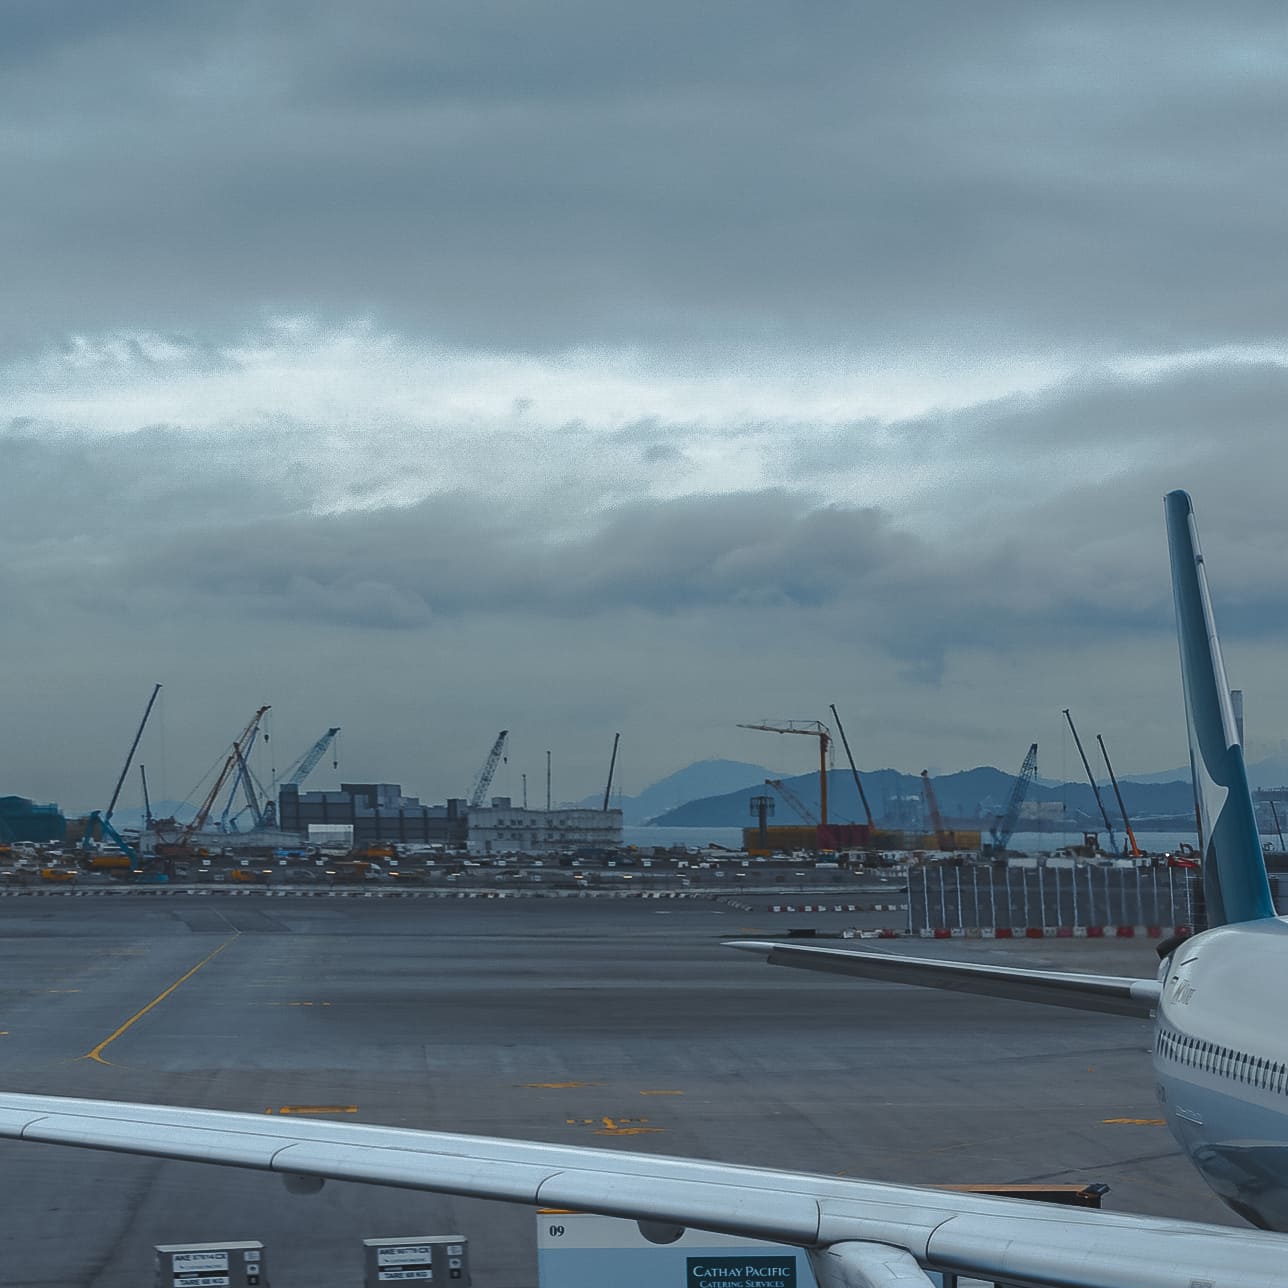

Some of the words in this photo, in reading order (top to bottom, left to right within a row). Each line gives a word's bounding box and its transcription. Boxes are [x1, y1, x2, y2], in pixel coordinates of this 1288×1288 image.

[549, 1224, 565, 1237] 09
[692, 1265, 744, 1277] CATHAY
[745, 1266, 791, 1277] PACIFIC
[699, 1280, 744, 1288] CATERING
[745, 1279, 785, 1288] SERVICES
